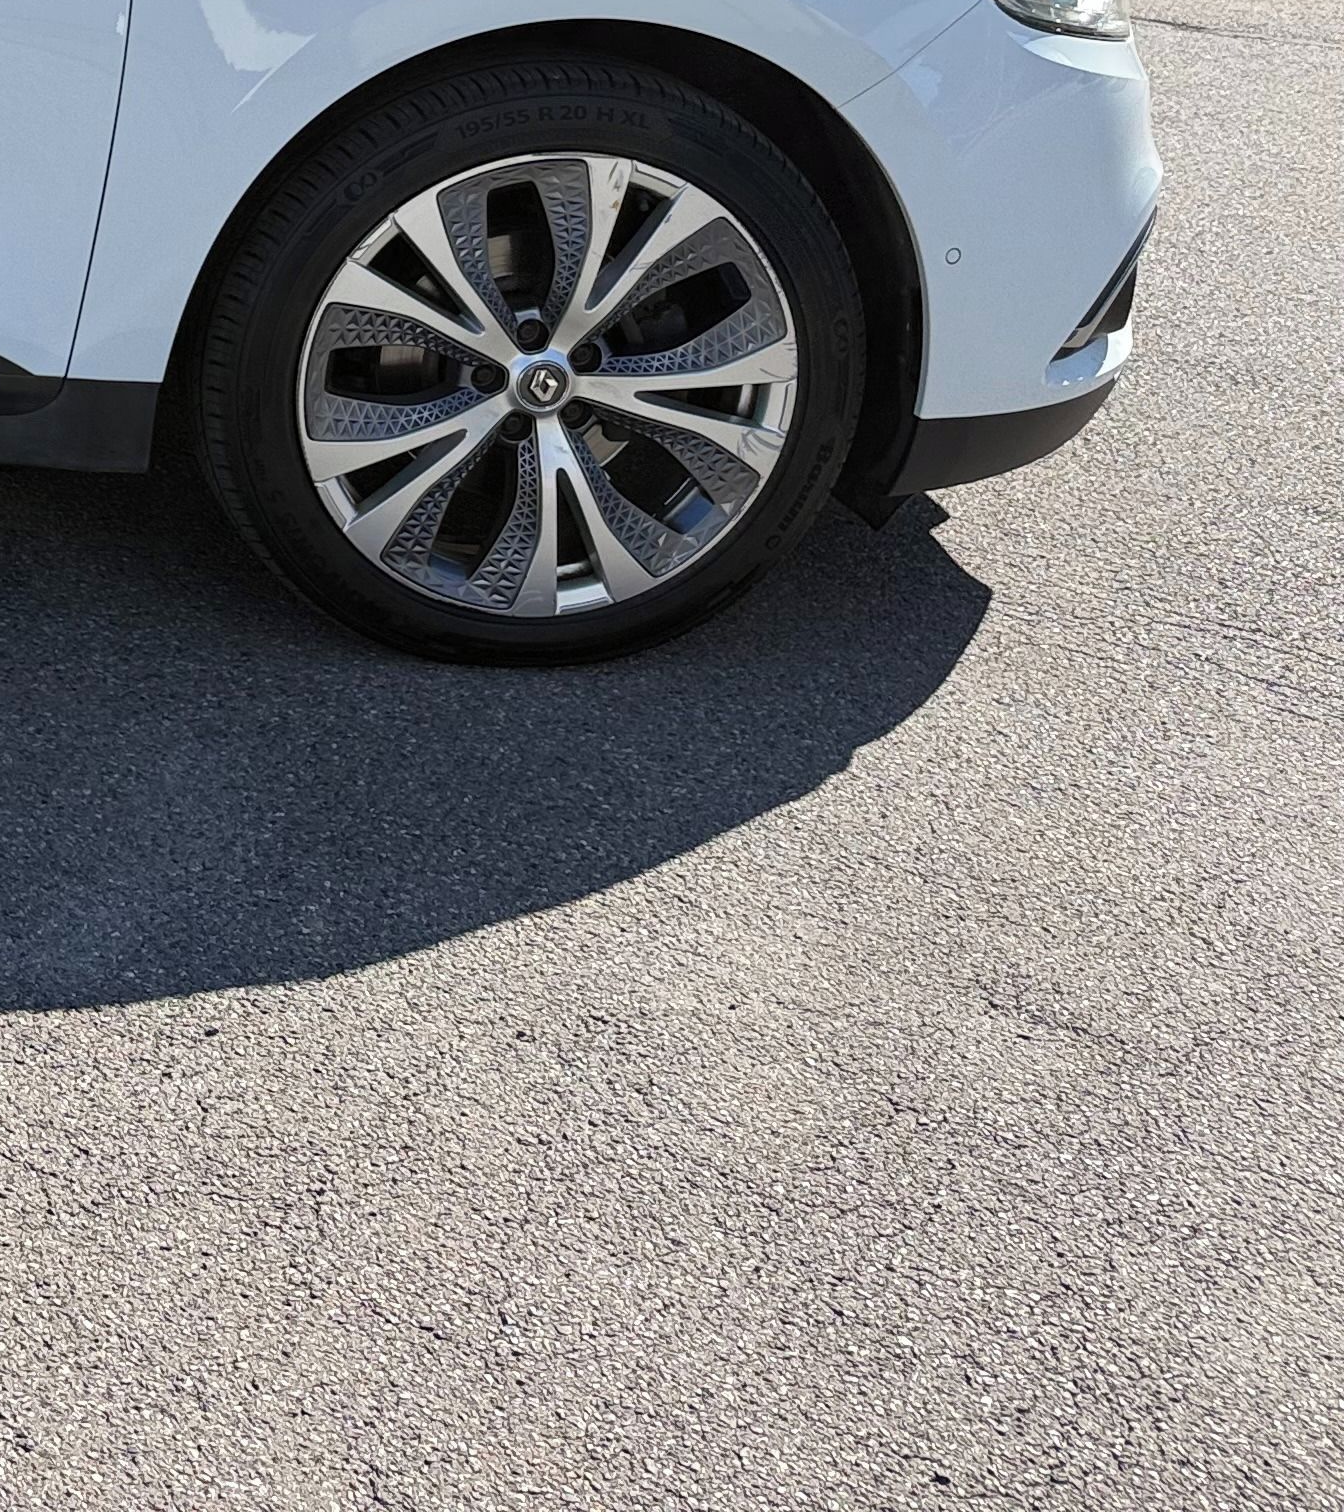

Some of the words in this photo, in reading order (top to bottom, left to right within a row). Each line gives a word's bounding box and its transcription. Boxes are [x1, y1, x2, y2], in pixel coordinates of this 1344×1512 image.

[455, 109, 530, 138] 195/55
[538, 106, 553, 120] R
[559, 105, 587, 120] 20
[596, 106, 614, 122] H
[621, 109, 650, 129] XL
